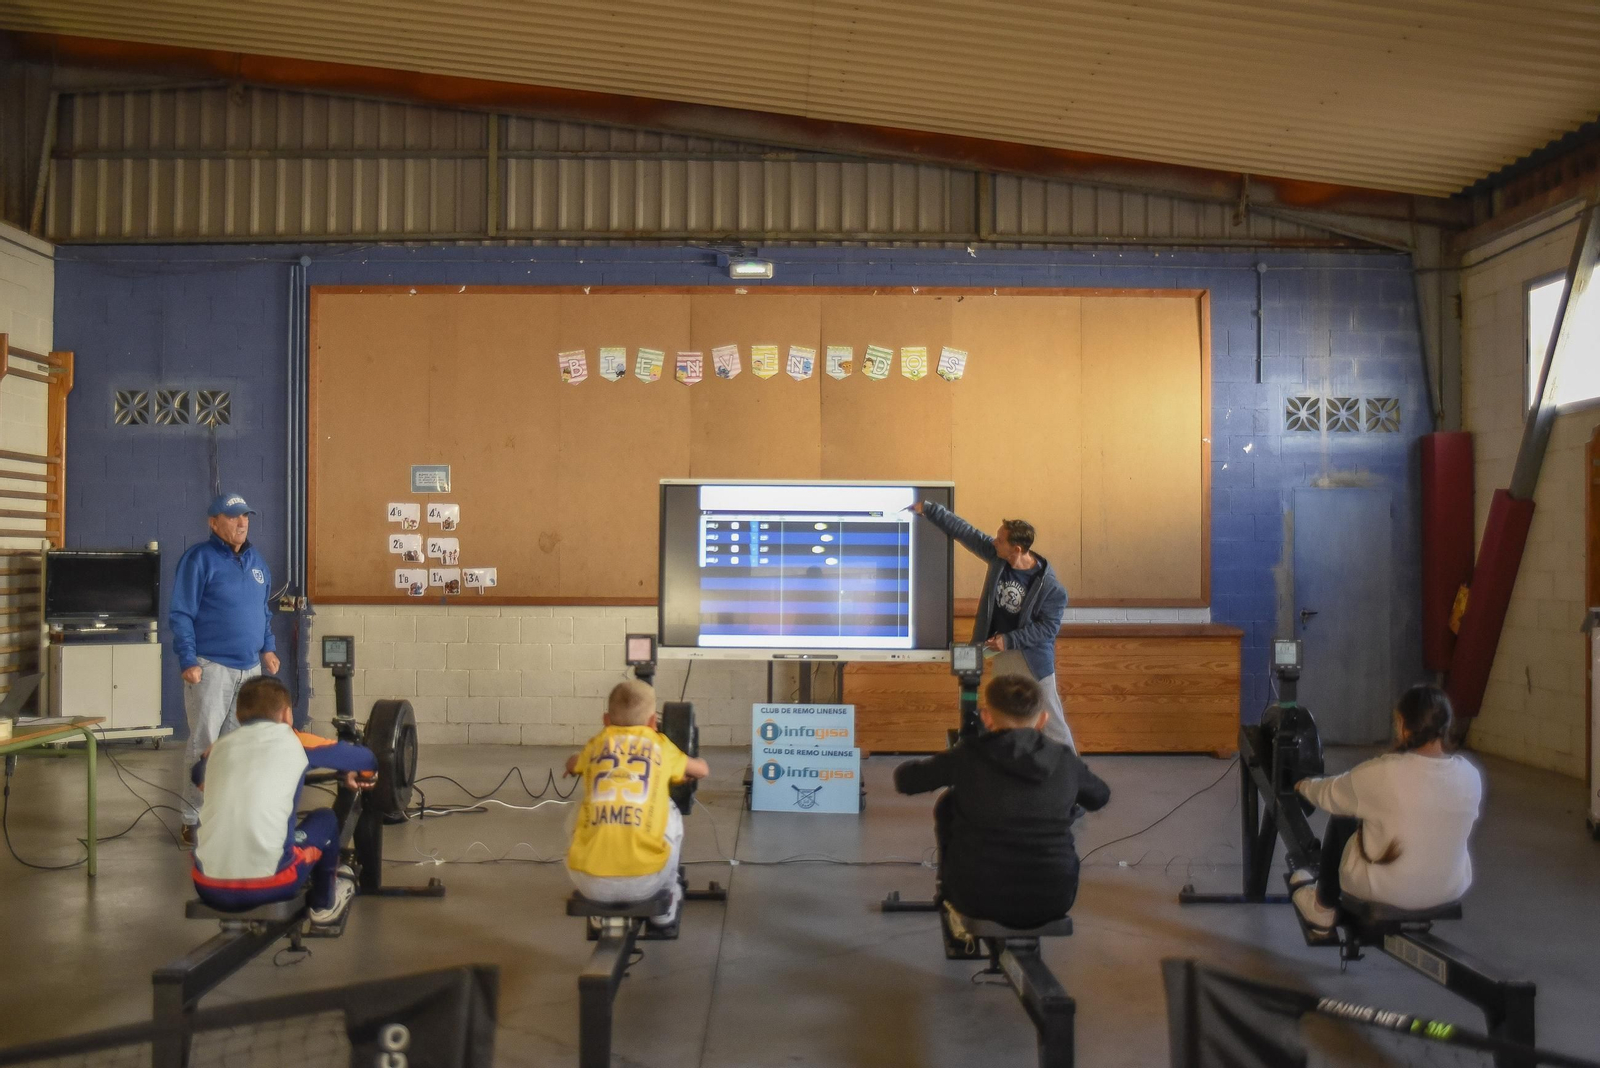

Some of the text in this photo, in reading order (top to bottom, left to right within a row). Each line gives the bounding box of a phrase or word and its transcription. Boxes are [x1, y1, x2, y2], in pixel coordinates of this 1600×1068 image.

[784, 726, 849, 740] infogisa
[763, 747, 783, 755] CLUB
[591, 754, 650, 804] 23
[786, 766, 854, 781] infogisa
[591, 805, 643, 826] JAMES
[1317, 997, 1375, 1021] TENNIS
[1374, 1009, 1410, 1028] NET
